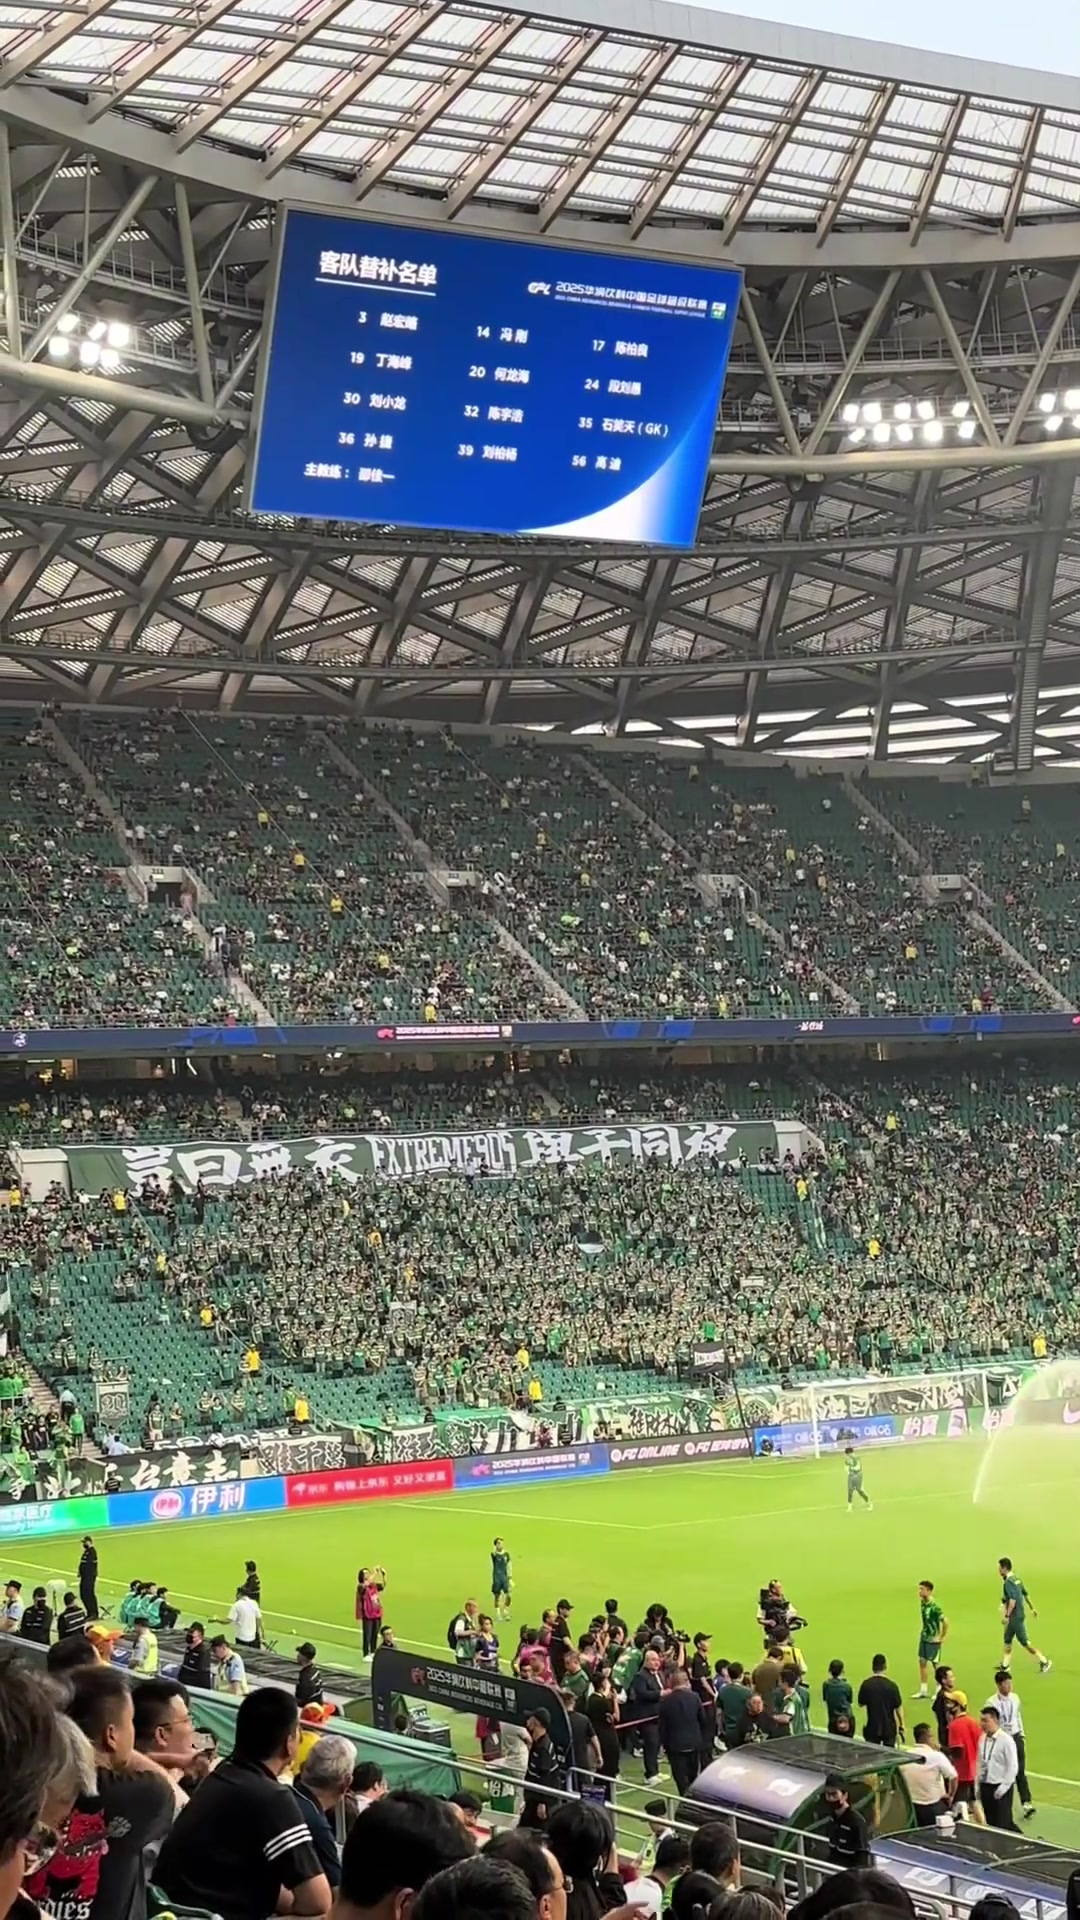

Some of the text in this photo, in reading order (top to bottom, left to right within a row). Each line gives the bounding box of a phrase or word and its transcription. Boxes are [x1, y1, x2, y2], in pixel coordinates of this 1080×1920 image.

[319, 250, 437, 286] 客队替补名单
[359, 312, 367, 323] 3
[477, 326, 490, 338] 14
[593, 340, 605, 351] 17
[351, 352, 365, 364] 19
[469, 366, 486, 377] 20
[584, 379, 600, 390] 24
[344, 392, 361, 404] 30
[464, 405, 479, 417] 32
[578, 417, 593, 428] 35
[338, 432, 355, 444] 36
[458, 444, 474, 456] 39
[572, 455, 587, 467] 56
[639, 1444, 680, 1458] ONLINE
[191, 1483, 245, 1514] 伊利
